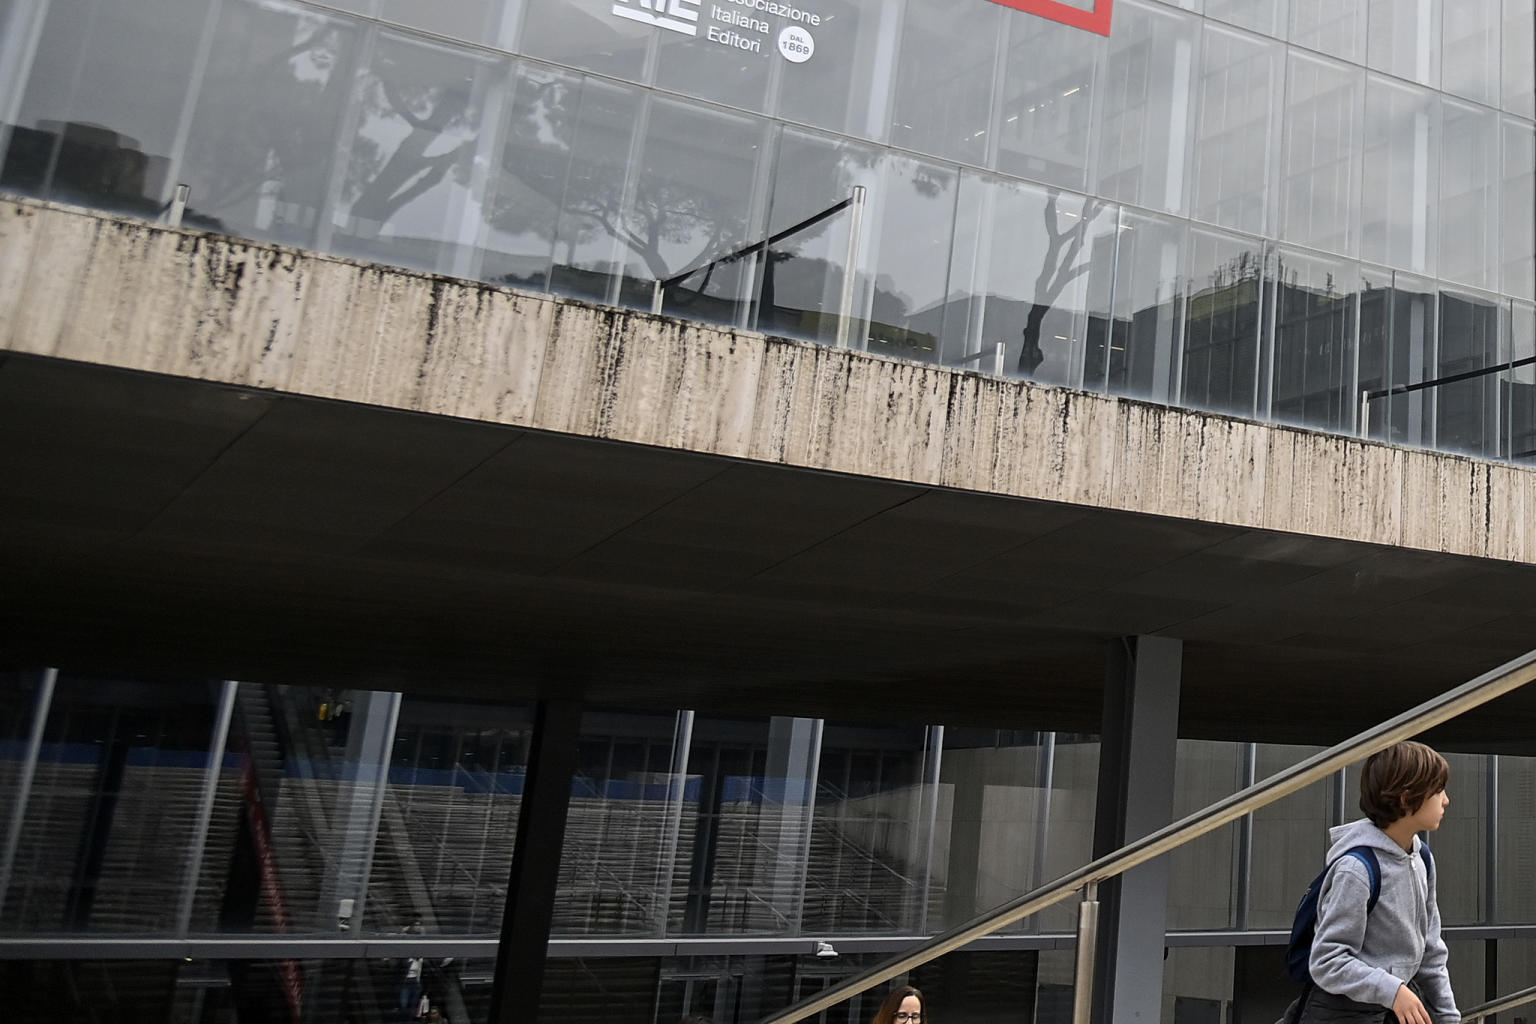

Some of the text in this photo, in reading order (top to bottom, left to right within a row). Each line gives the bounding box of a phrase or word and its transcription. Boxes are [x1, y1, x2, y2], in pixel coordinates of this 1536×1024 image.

[710, 5, 770, 34] Italiana
[707, 27, 762, 53] Editori
[783, 41, 810, 55] 1869
[790, 34, 804, 43] DAL
